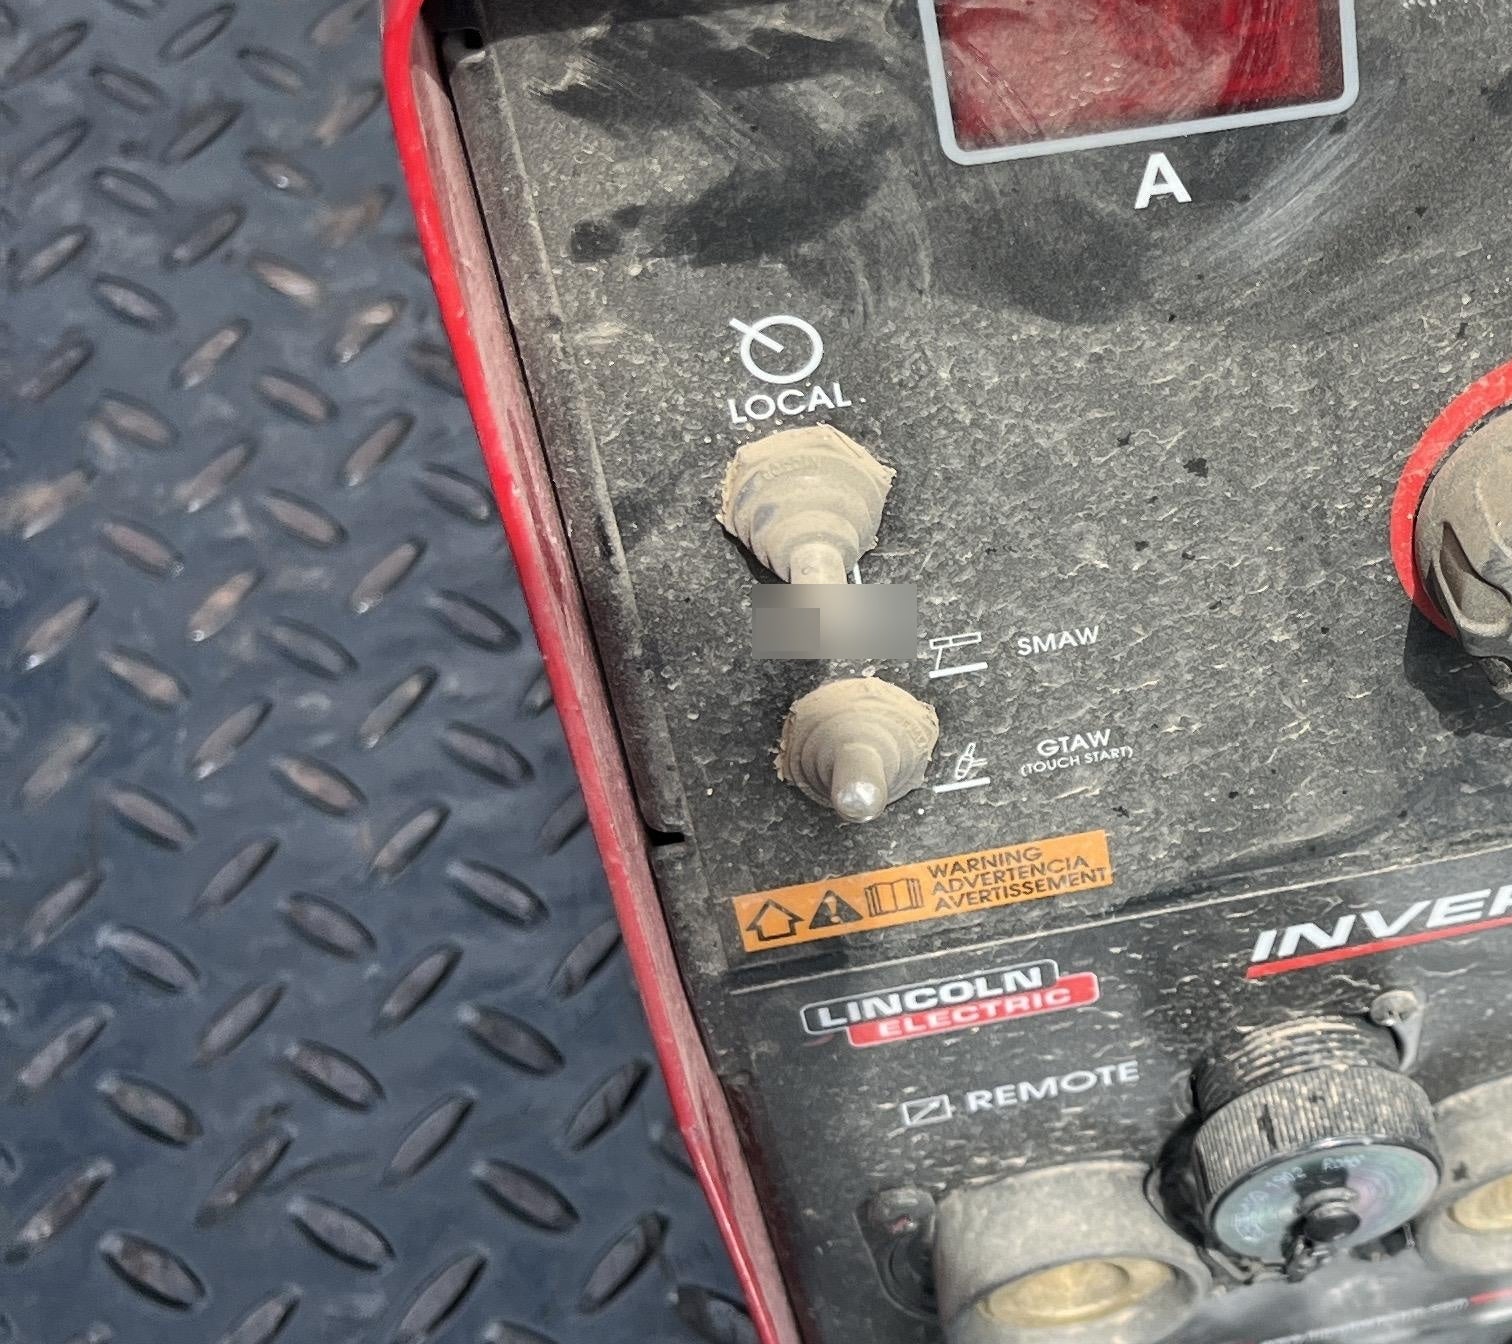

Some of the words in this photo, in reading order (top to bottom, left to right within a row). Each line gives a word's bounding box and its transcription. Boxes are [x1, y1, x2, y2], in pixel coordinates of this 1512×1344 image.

[1134, 152, 1192, 211] A
[727, 381, 853, 425] LOCAL
[1017, 625, 1101, 657] SMAW
[1020, 755, 1081, 777] (TOUCH
[1084, 745, 1134, 764] START)
[1036, 728, 1111, 757] GTAW
[927, 844, 1043, 878] WARNING
[931, 855, 1090, 896] ADVERTENCIA
[935, 866, 1107, 913] AVERTISSEMENT
[817, 965, 1044, 1029] LINCOLN
[878, 987, 1073, 1038] ELECTRIC
[966, 1060, 1140, 1114] REMOTE
